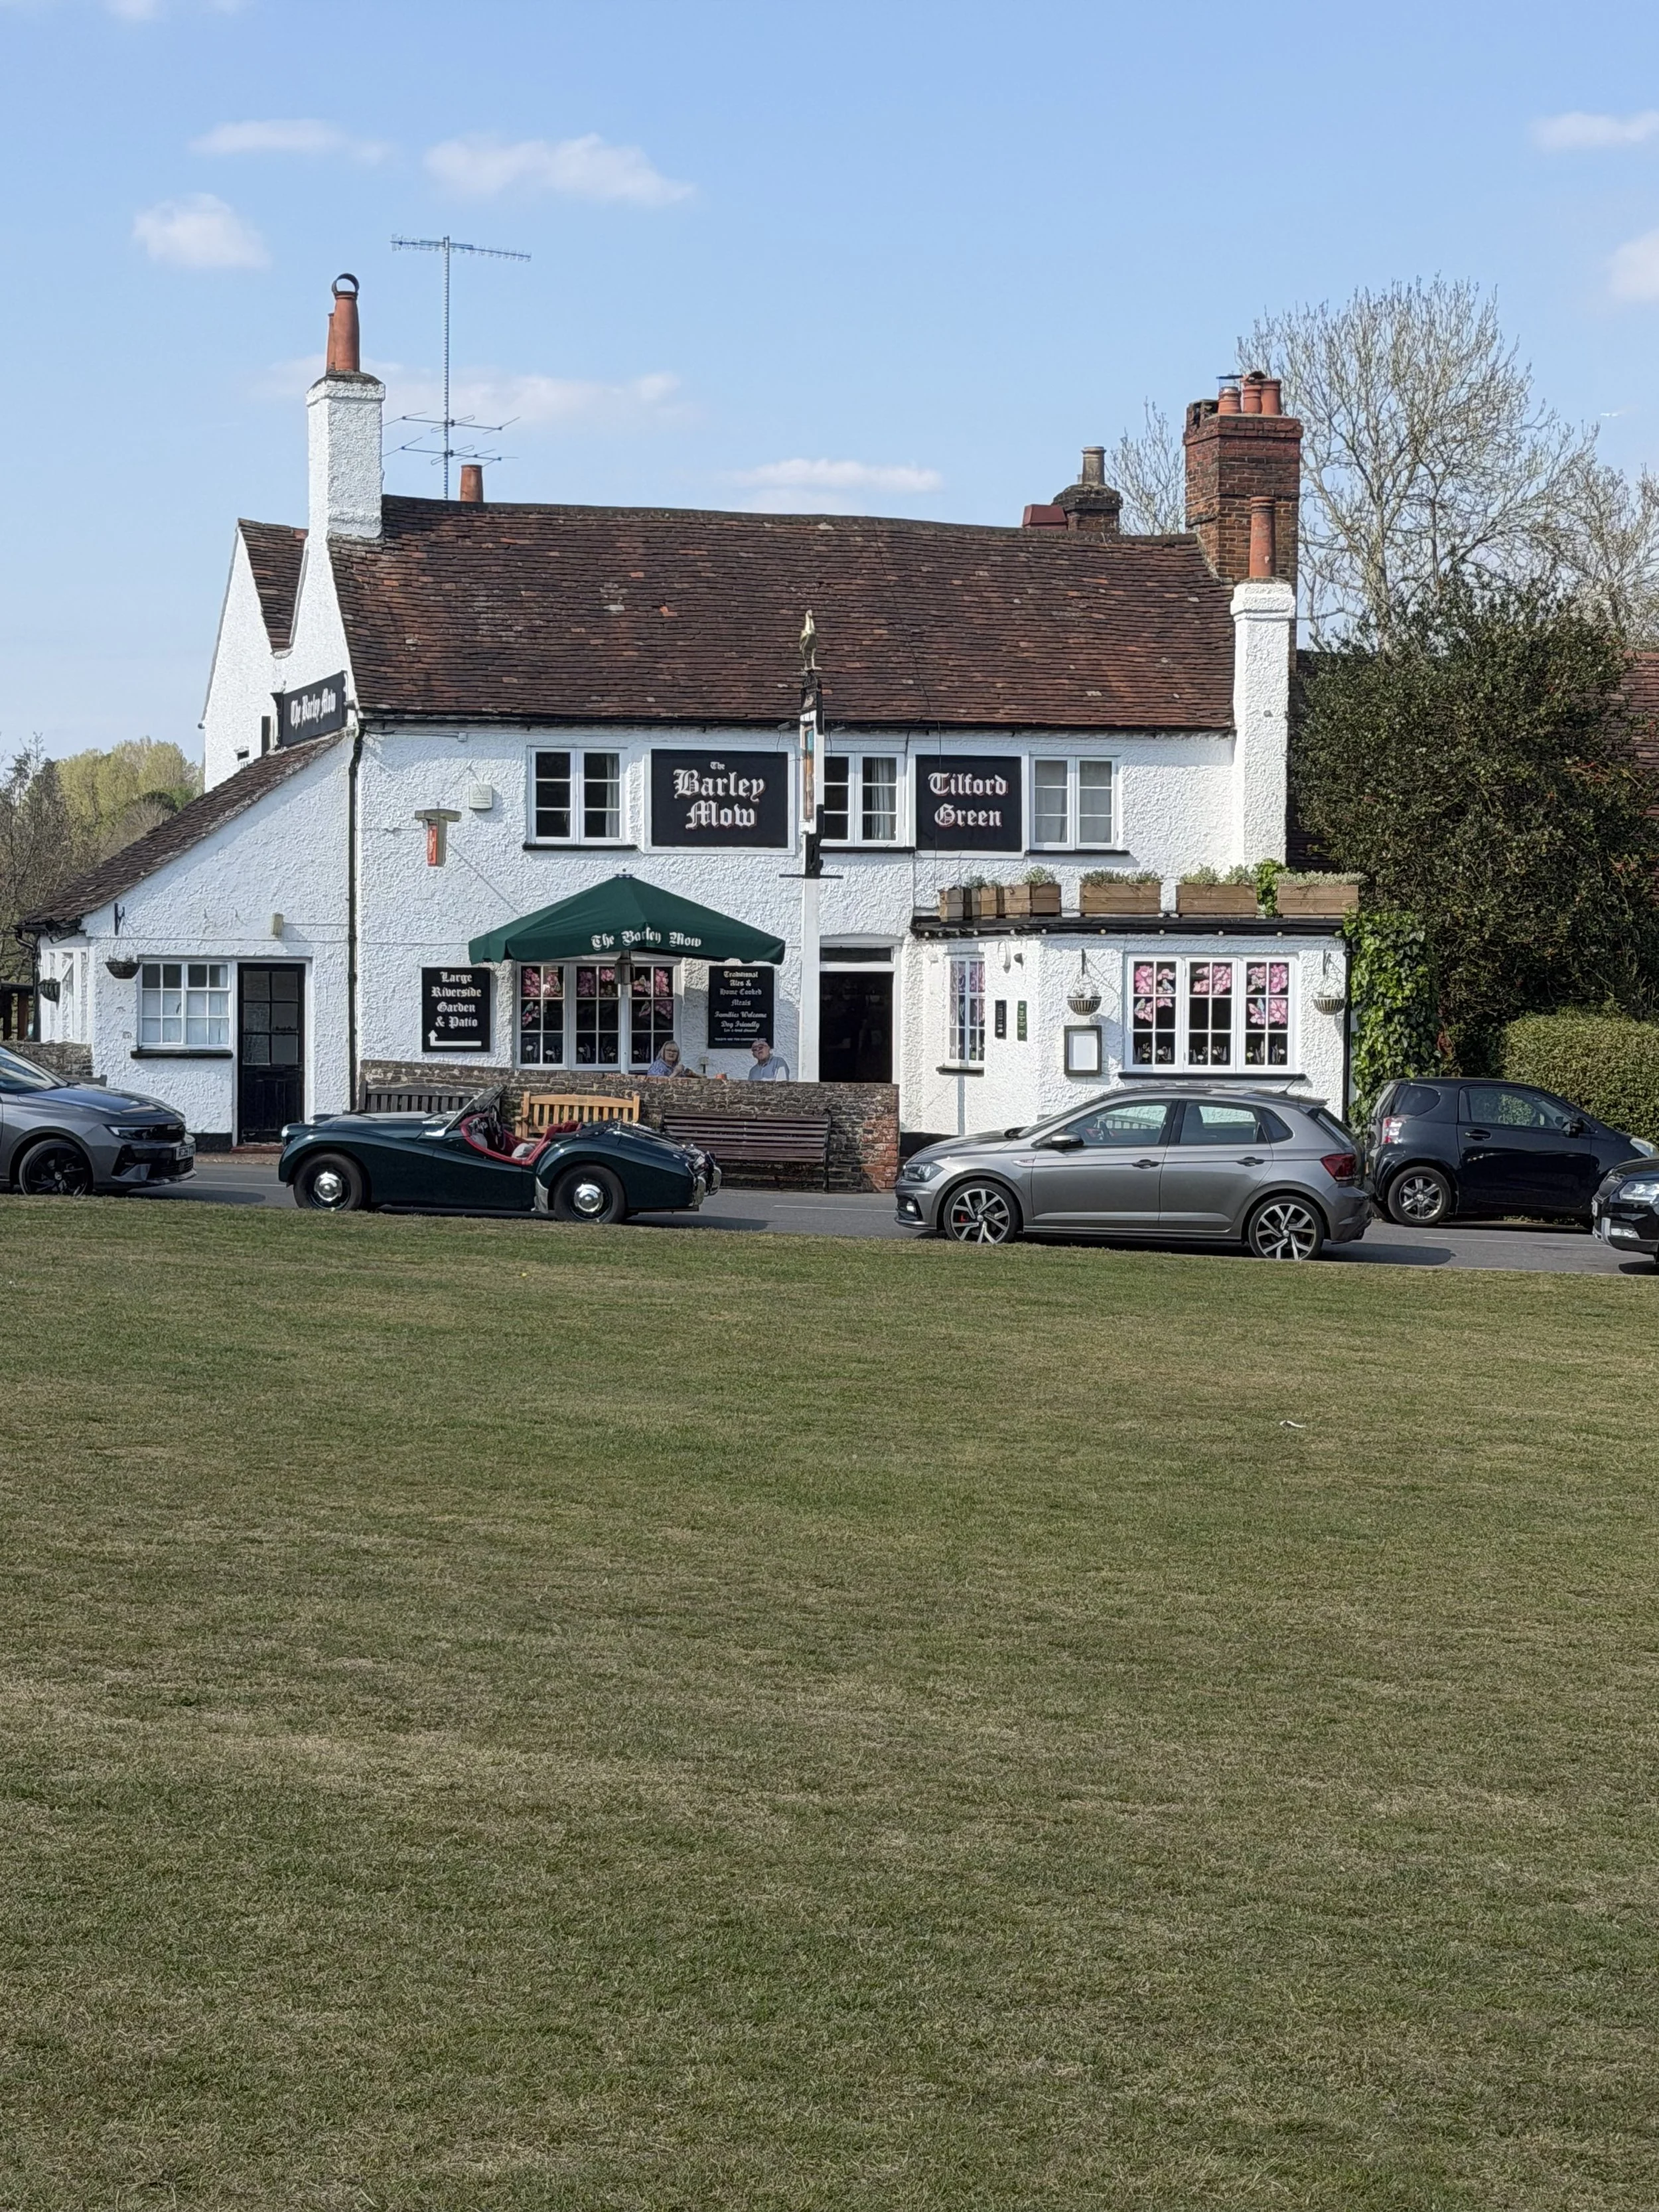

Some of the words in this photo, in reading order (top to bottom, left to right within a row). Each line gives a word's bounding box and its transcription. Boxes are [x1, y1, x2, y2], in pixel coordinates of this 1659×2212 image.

[710, 761, 725, 770] The
[673, 769, 766, 802] Barley
[928, 772, 1008, 796] Tilford
[685, 800, 757, 830] Mow
[934, 803, 1002, 827] Green
[591, 933, 614, 951] The
[621, 926, 662, 946] Barley
[668, 932, 702, 948] Mow
[439, 971, 472, 984] Large
[431, 986, 482, 997] Riverside
[437, 1001, 476, 1013] Garden
[435, 1015, 445, 1027] &
[448, 1015, 478, 1029] Patio
